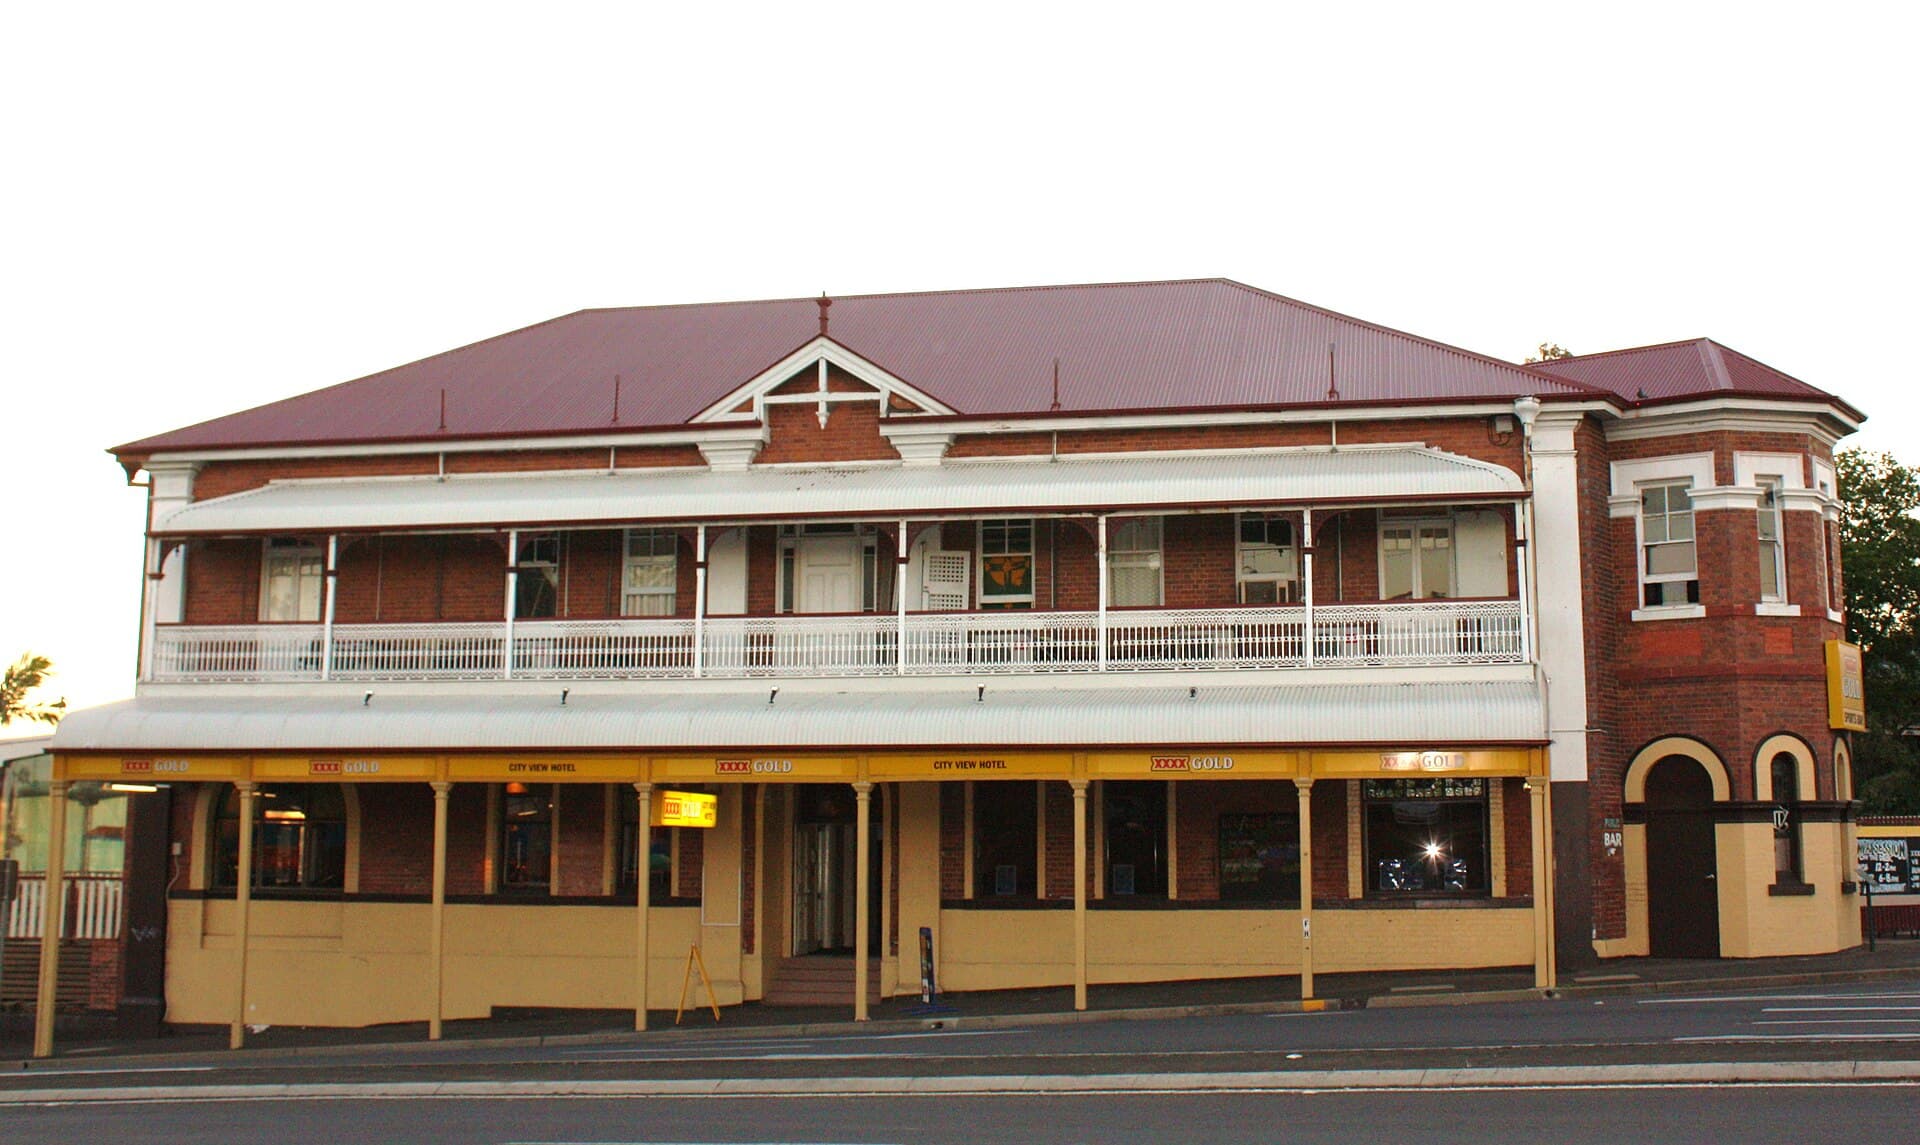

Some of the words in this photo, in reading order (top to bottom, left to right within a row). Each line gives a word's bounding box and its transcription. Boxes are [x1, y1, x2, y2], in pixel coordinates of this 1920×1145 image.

[154, 759, 189, 771] GOLD
[344, 760, 379, 773] GOLD
[509, 763, 526, 771] CITY
[529, 763, 548, 771] VIEW
[551, 763, 576, 771] HOTEL
[719, 762, 748, 771] XXXX
[753, 759, 792, 773] GOLD
[934, 761, 952, 769] CITY
[955, 761, 976, 769] VIEW
[979, 760, 1007, 768] HOTEL
[1155, 758, 1186, 769] XXXX
[1192, 756, 1233, 770] GOLD
[1604, 832, 1622, 847] BAR
